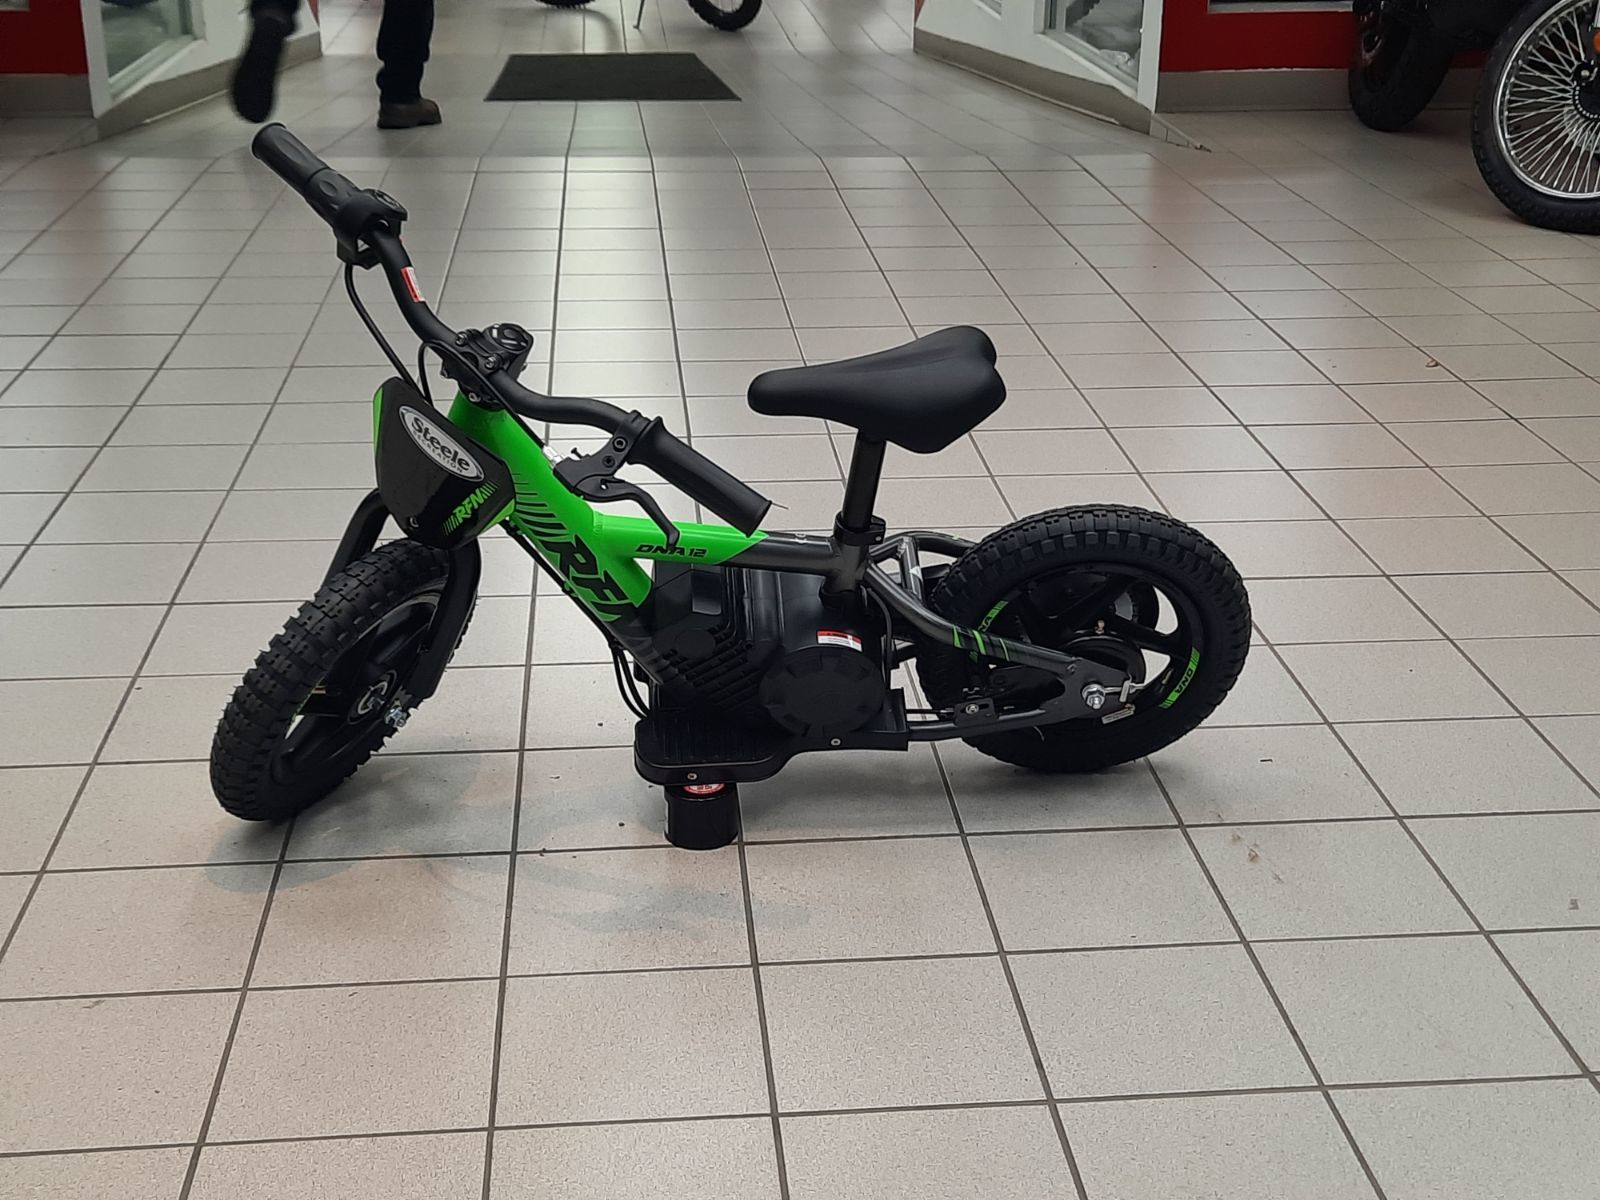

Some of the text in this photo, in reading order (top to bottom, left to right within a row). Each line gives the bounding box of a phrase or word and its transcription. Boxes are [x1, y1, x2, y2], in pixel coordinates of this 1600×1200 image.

[411, 416, 471, 471] Steele
[453, 488, 485, 523] RFN
[635, 544, 708, 558] DNA 12
[1174, 667, 1194, 694] DNA
